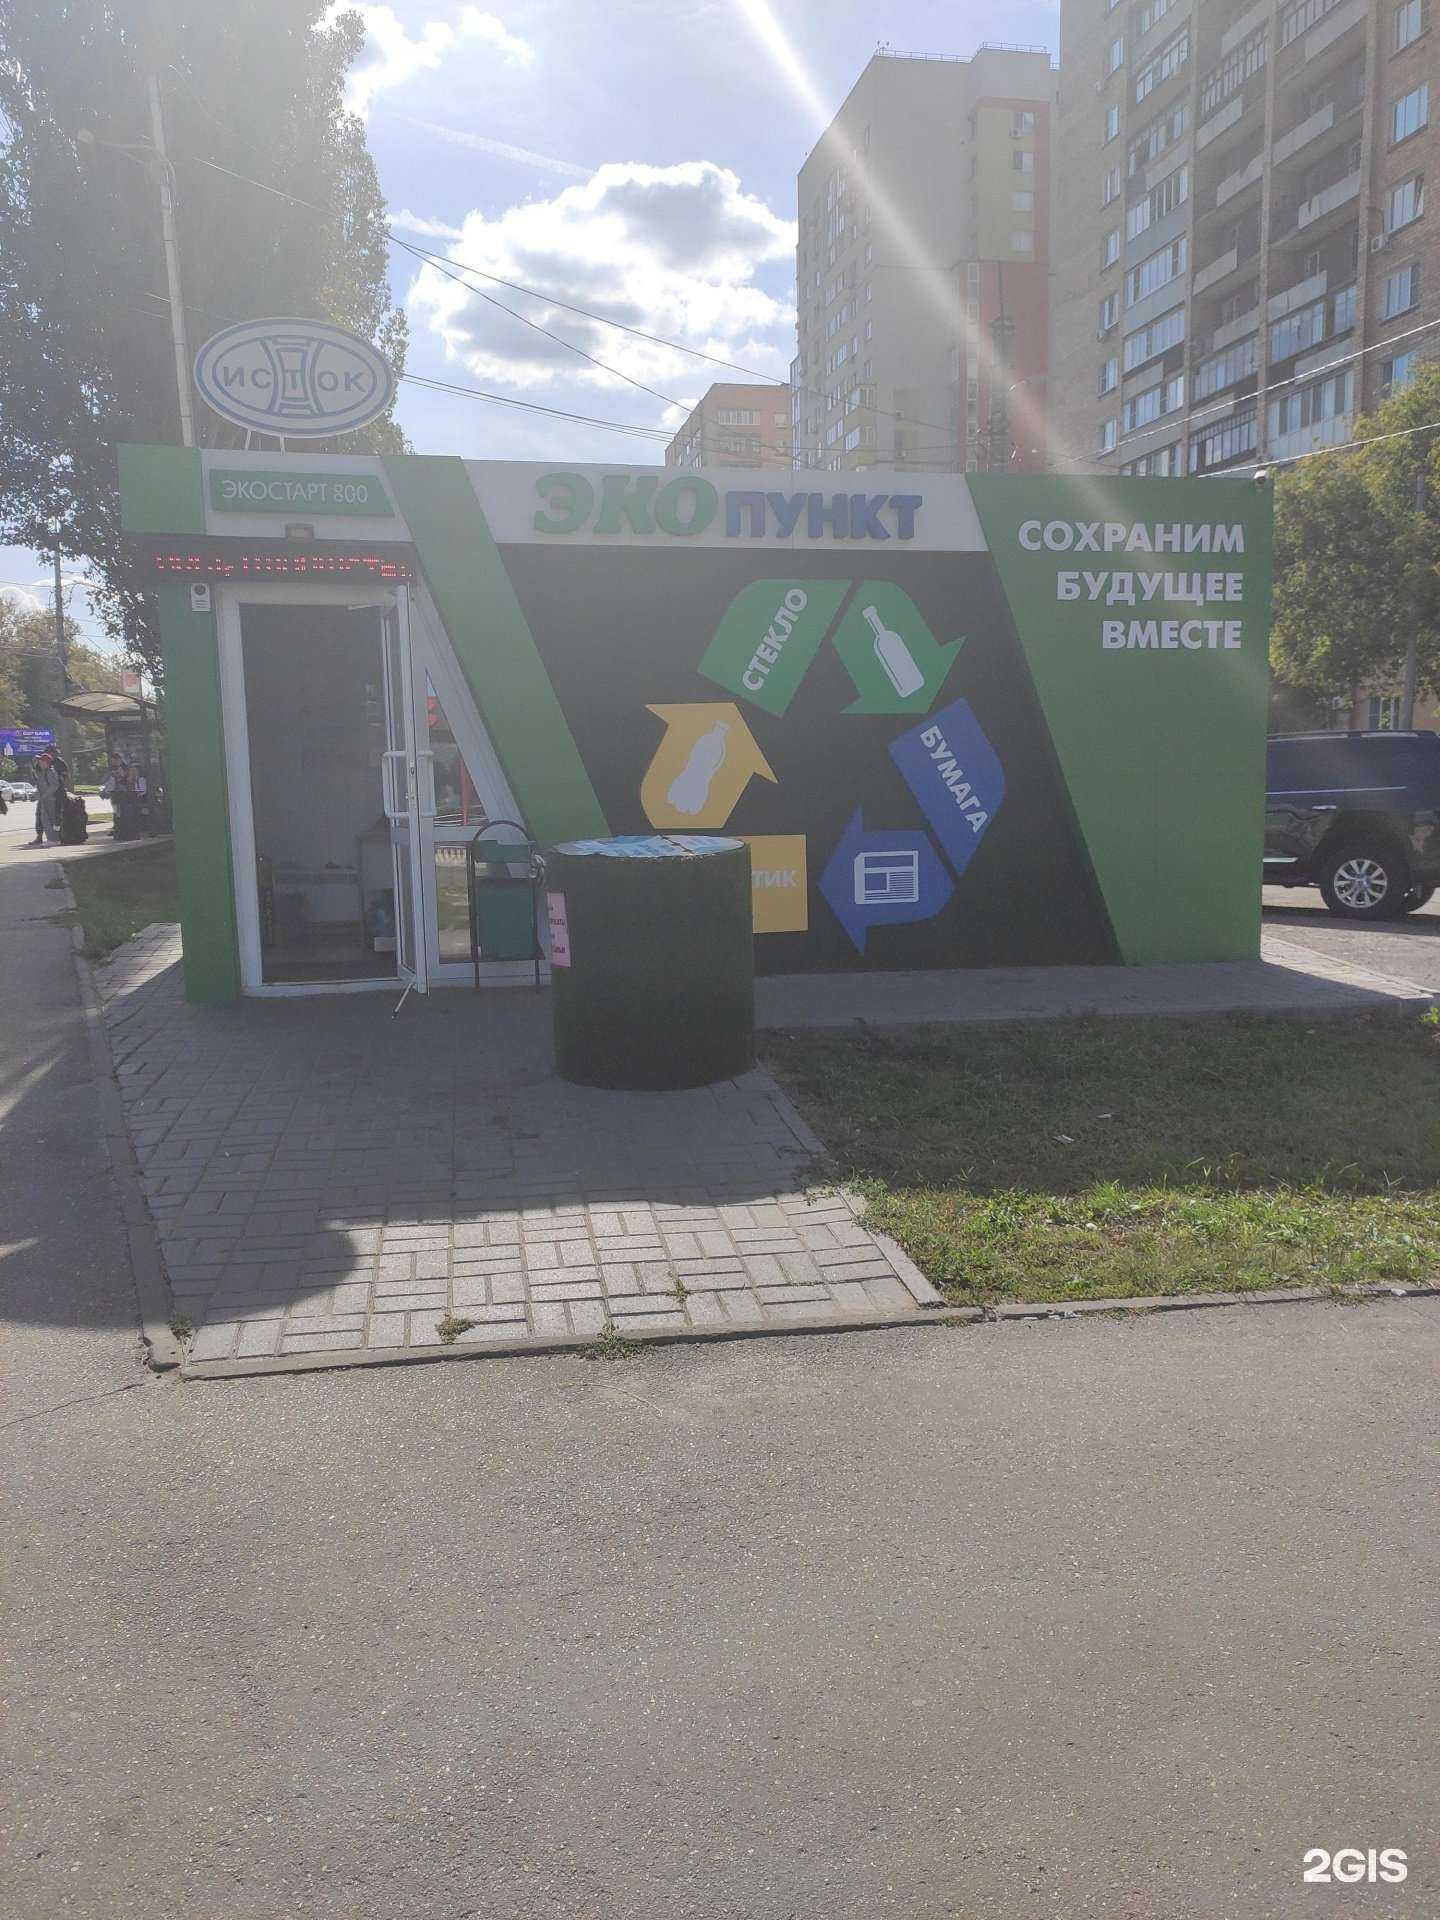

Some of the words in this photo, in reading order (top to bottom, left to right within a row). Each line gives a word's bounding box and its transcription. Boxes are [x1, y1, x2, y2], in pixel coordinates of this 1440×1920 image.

[222, 366, 367, 392] ИСТОК
[221, 479, 329, 501] ЭКОСТАРТ
[333, 483, 369, 503] 800
[1017, 520, 1245, 553] СОХРАНИМ
[1056, 571, 1244, 607] БУДУЩЕЕ
[742, 588, 808, 691] СТЕКЛО
[1101, 619, 1242, 649] ВМЕСТЕ
[919, 725, 990, 833] БУМАГА
